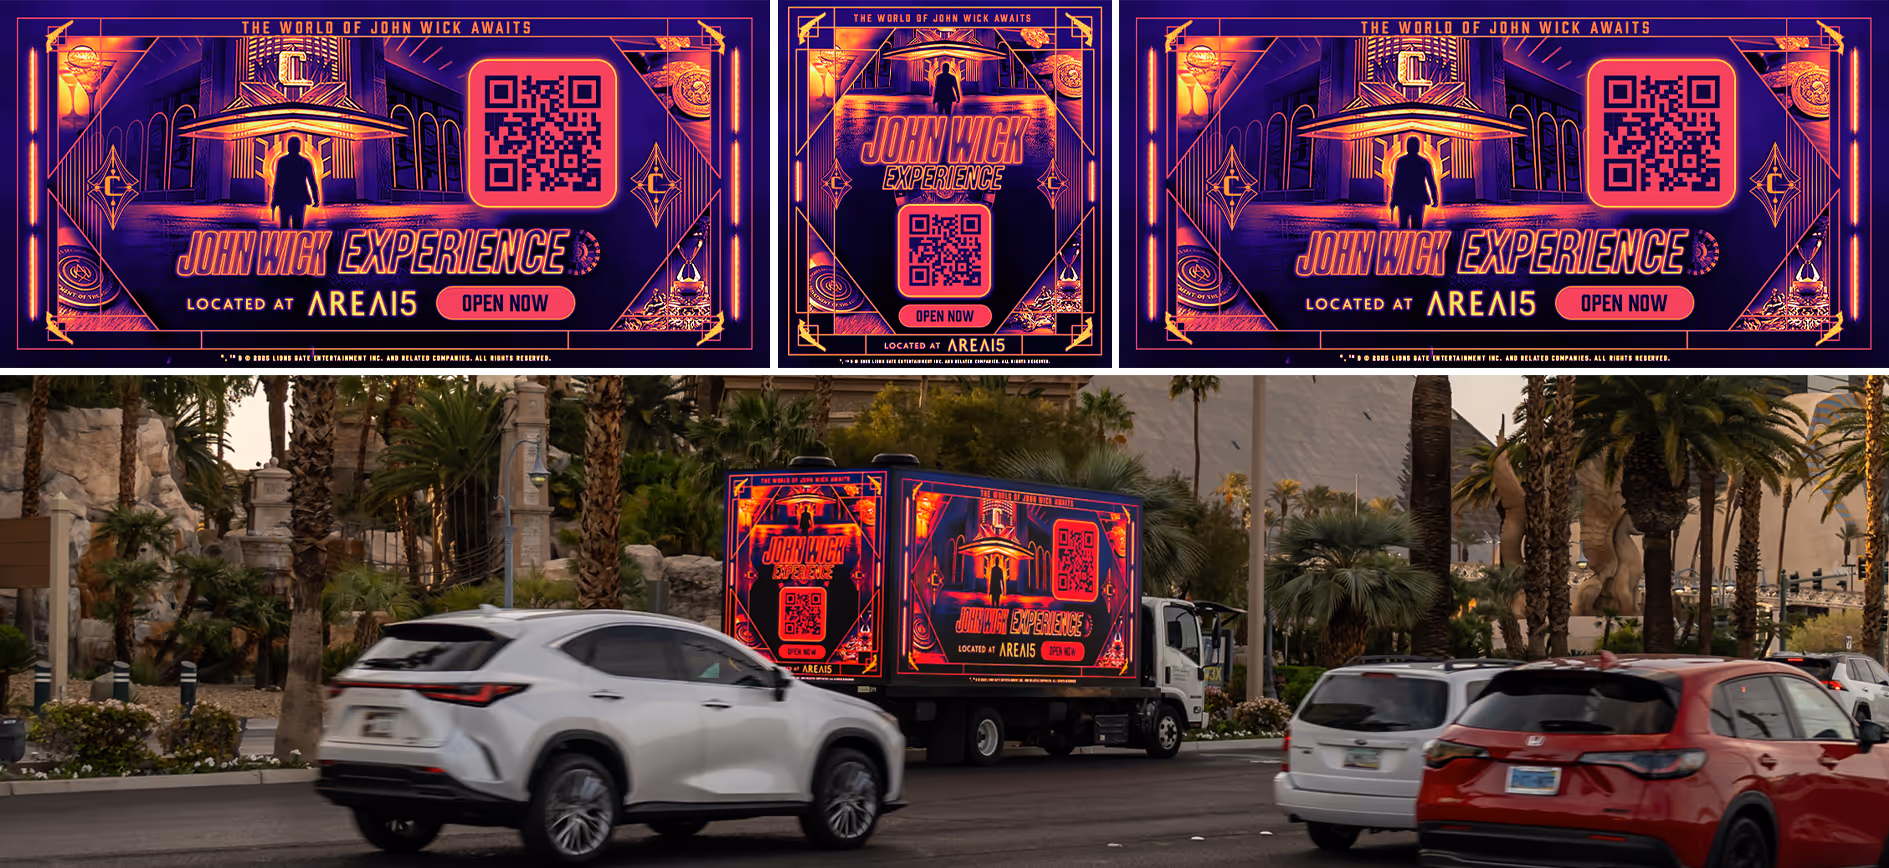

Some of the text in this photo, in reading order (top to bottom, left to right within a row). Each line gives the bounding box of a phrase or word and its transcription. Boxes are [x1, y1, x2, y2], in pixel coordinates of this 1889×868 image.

[854, 13, 1031, 23] THE WORLD OF JOHN WICK AWAITS
[242, 20, 531, 35] THE WORLD OF JOHN WICK AWAITS
[1361, 20, 1650, 35] THE WORLD OF JOHN WICK AWAITS
[861, 116, 1030, 164] JOHN WICK
[882, 165, 1005, 190] EXPERIENCE
[177, 228, 571, 276] JOHN WICK EXPERIENCE
[1296, 228, 1690, 276] JOHN WICK EXPERIENCE
[187, 298, 265, 310] LOCATED
[274, 298, 294, 310] AT
[462, 294, 548, 312] OPEN NOW
[1306, 298, 1384, 310] LOCATED
[1393, 298, 1413, 310] AT
[1581, 294, 1667, 312] OPEN NOW
[916, 310, 974, 322] OPEN NOW
[885, 342, 925, 350] LOCATED
[930, 342, 941, 350] AT
[386, 354, 399, 362] AND
[475, 354, 487, 362] ALL
[1505, 354, 1518, 362] AND
[1594, 354, 1606, 362] ALL
[762, 536, 849, 565] JOHN WICK
[772, 565, 835, 579] EXPERIENCE
[955, 606, 1084, 637] JOHN WICK EXPERIENCE
[787, 648, 801, 656] OPEN
[958, 645, 987, 653] LOCATED
[1049, 646, 1076, 656] OPEN NOW
